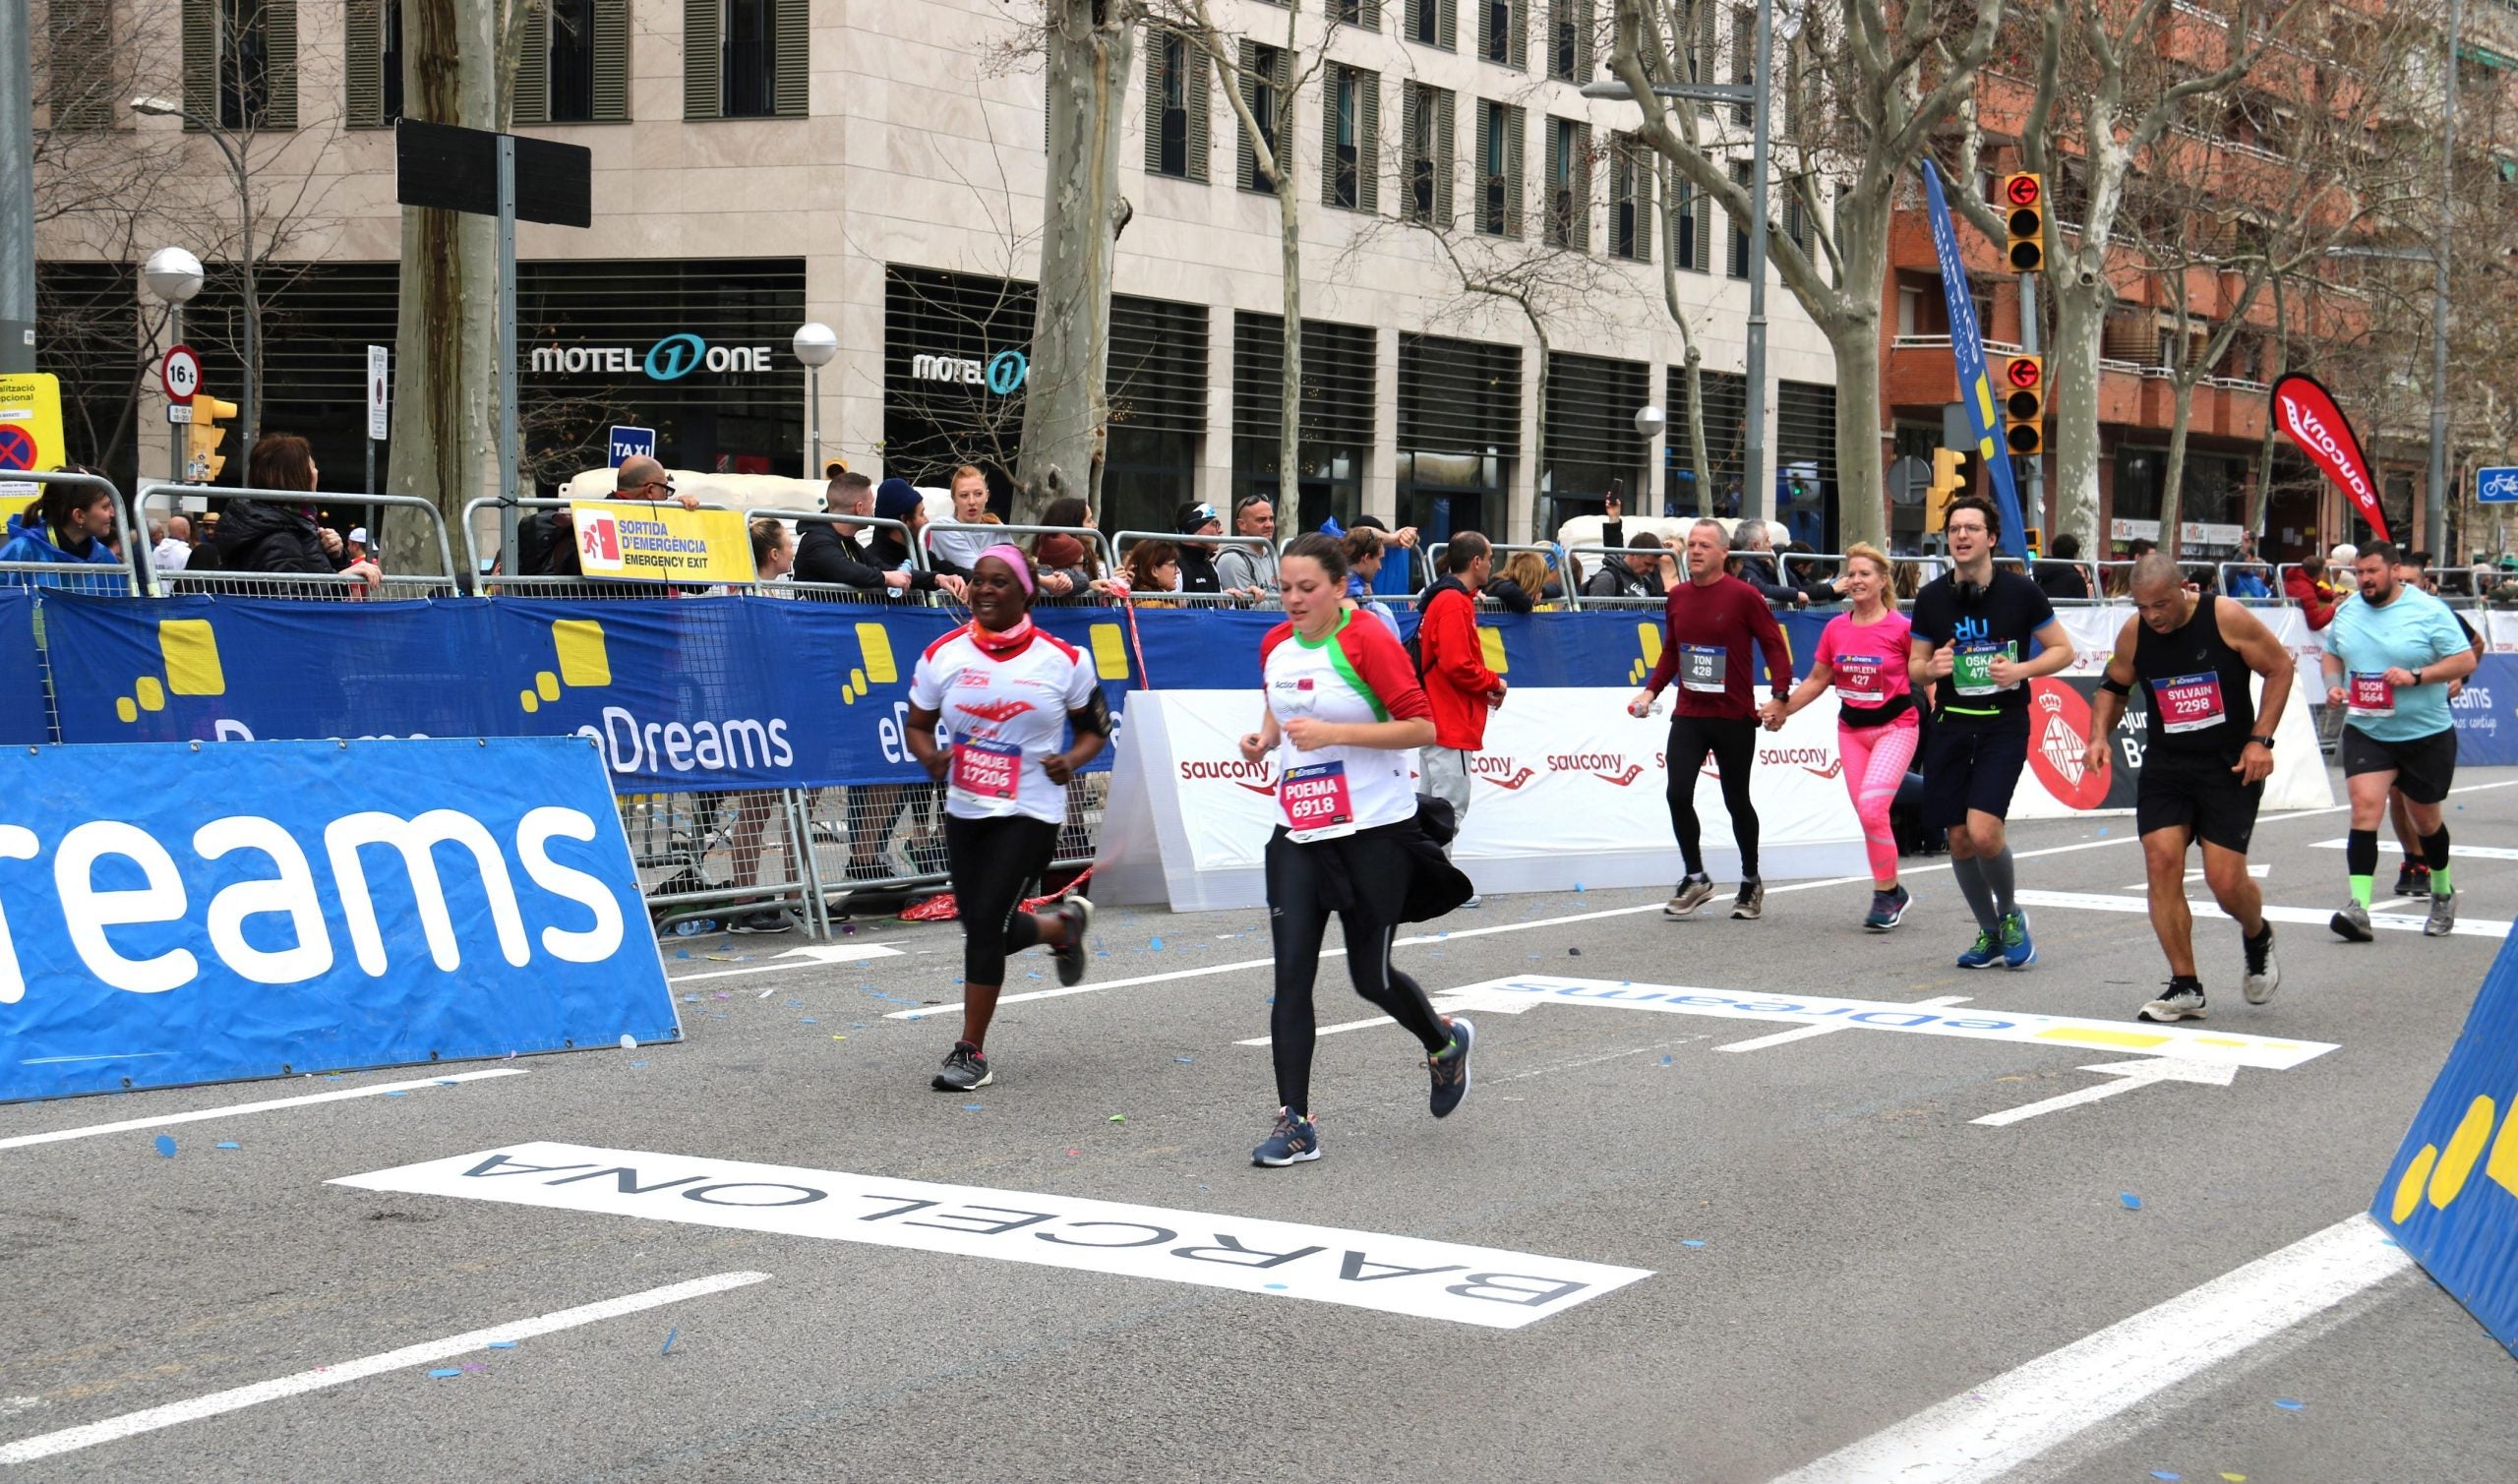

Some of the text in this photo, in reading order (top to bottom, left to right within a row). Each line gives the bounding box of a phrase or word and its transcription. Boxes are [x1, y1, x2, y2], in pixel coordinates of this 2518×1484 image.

[170, 365, 194, 384] 16 t
[614, 443, 650, 457] TAXI
[619, 519, 668, 536] SORTIDA
[622, 536, 706, 554] D'EMERGÈNCIA
[625, 554, 708, 568] EMERGENCY EXIT
[1693, 655, 1712, 666] TON
[1965, 654, 1994, 667] OSKA
[1692, 666, 1712, 677] 428
[1842, 666, 1877, 675] MARLEEN
[1851, 676, 1869, 685] 427
[2168, 685, 2212, 701] SYLVAIN
[2175, 698, 2210, 714] 2298
[963, 749, 1012, 770] RAQUEL
[1470, 755, 1512, 775] cony
[1547, 753, 1622, 773] saucony
[1760, 748, 1829, 766] saucony
[962, 765, 1011, 787] 17206
[1180, 761, 1269, 782] saucony
[1286, 779, 1339, 800] POEMA
[1291, 798, 1335, 818] 6918
[1491, 982, 2016, 1031] eDreams
[461, 1155, 1592, 1307] BARCELONA
